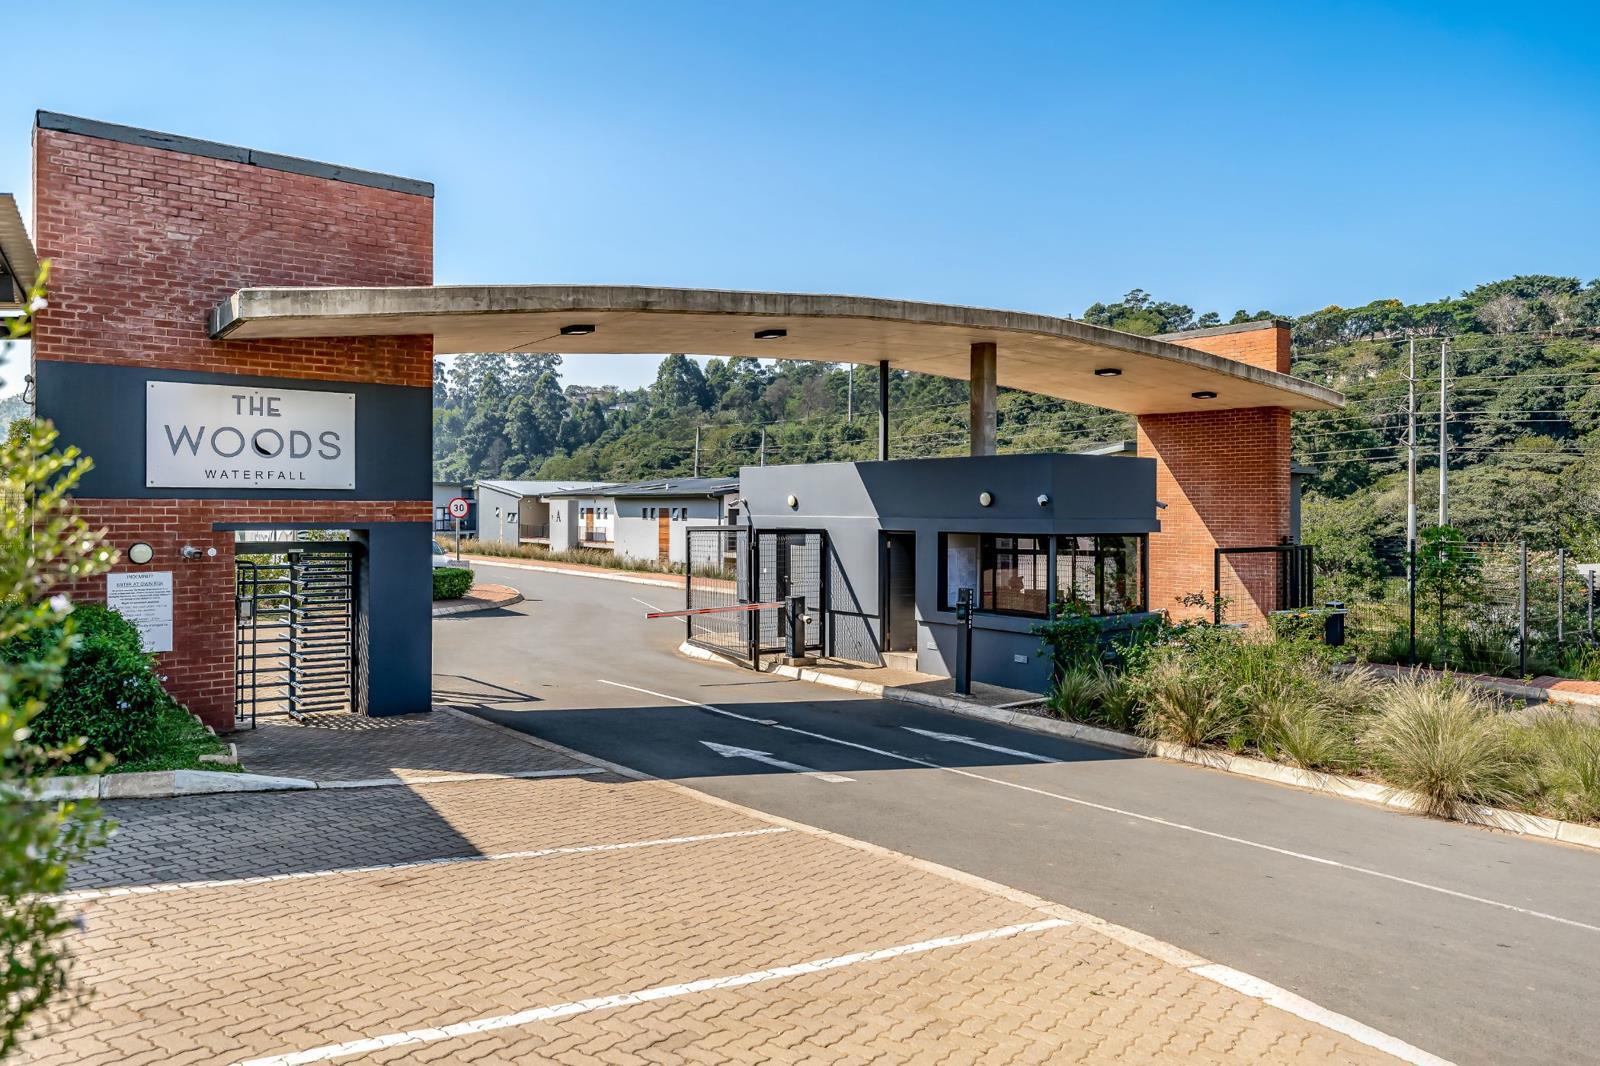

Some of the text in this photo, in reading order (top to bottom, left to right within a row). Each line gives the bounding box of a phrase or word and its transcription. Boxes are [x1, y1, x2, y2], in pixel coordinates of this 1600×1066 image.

[232, 395, 282, 417] THE
[164, 425, 341, 460] WOODS
[205, 470, 306, 480] WATERFALL
[454, 504, 464, 512] 30
